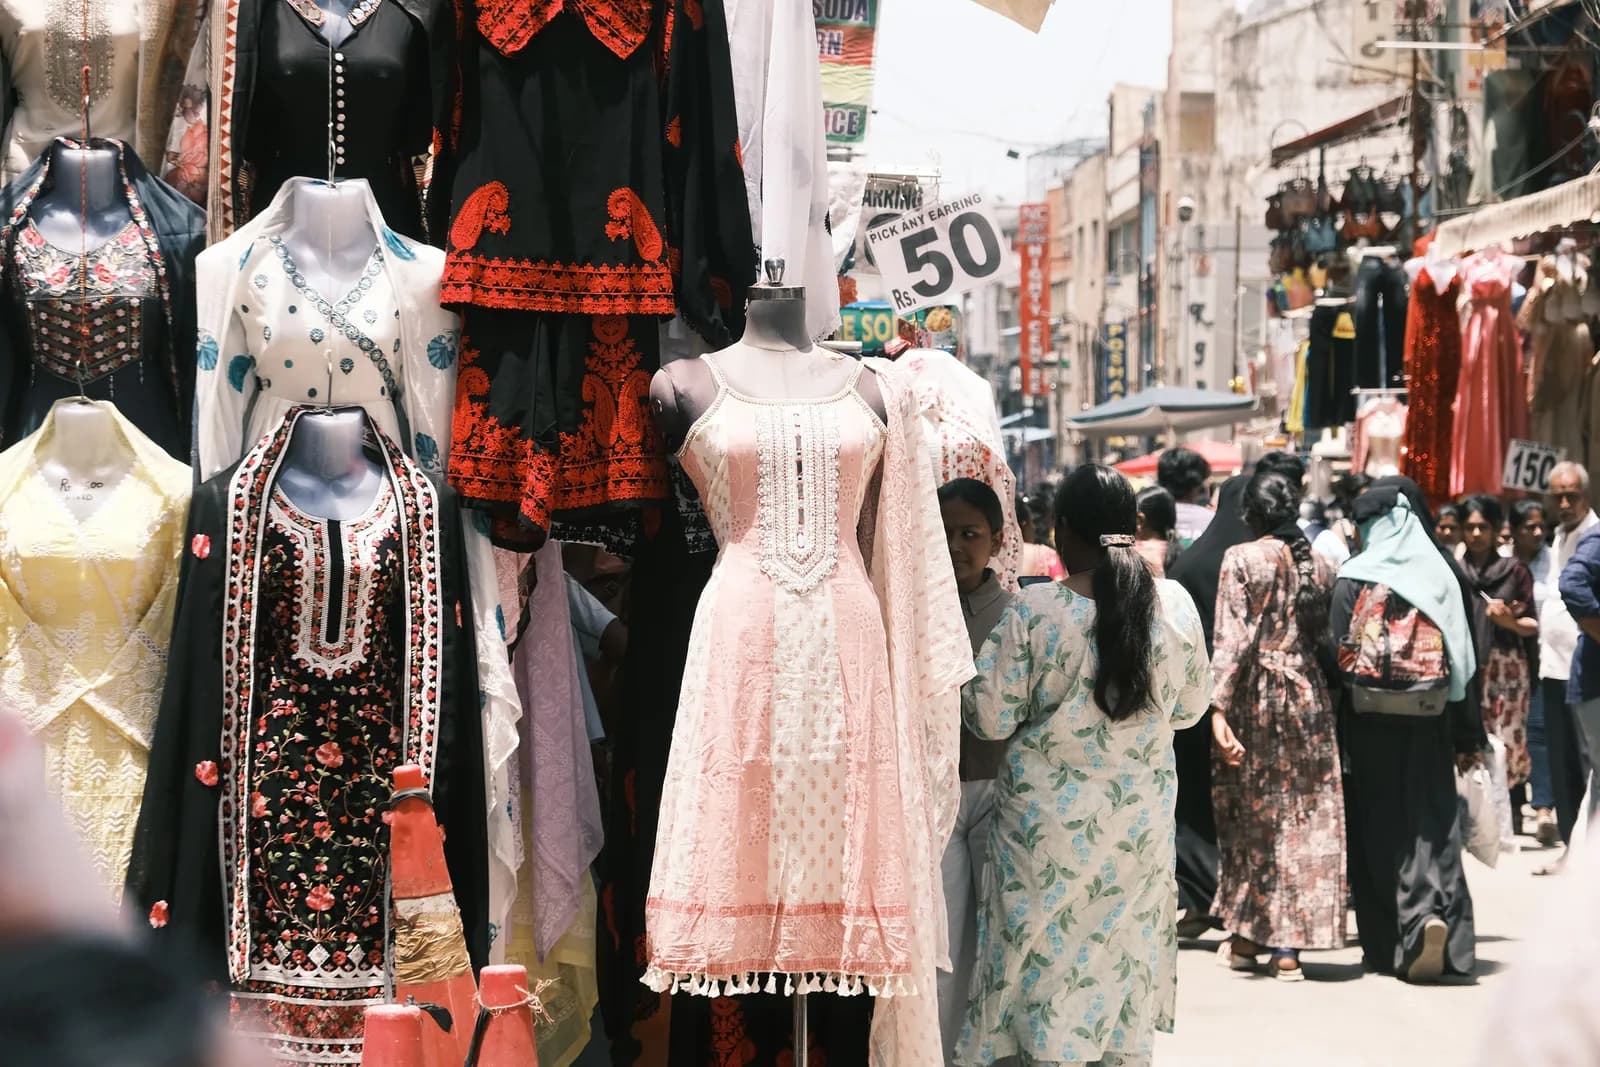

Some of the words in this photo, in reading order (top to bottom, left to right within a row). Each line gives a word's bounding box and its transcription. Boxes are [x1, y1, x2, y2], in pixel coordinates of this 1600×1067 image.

[813, 0, 868, 21] SODA
[862, 184, 922, 212] ARRING
[870, 225, 899, 243] PICK
[902, 215, 926, 232] ANY
[928, 193, 982, 221] EARRING
[900, 211, 1001, 297] 50
[892, 289, 917, 310] Rs.
[1512, 450, 1557, 490] 150
